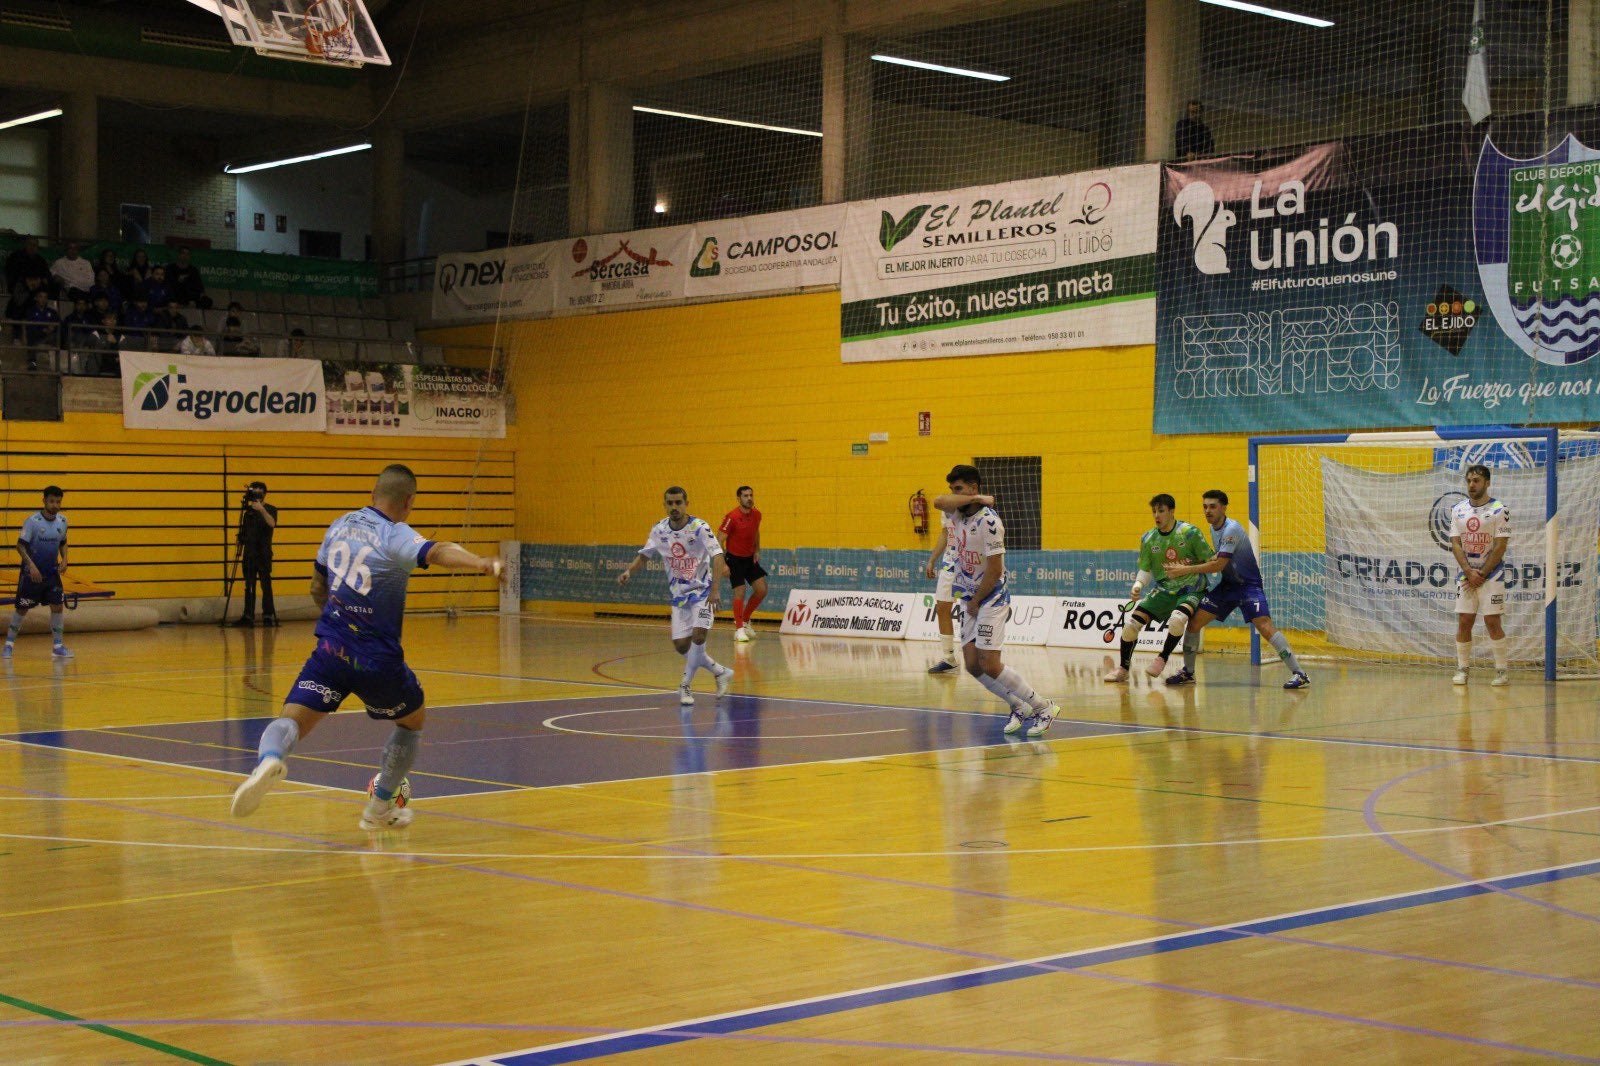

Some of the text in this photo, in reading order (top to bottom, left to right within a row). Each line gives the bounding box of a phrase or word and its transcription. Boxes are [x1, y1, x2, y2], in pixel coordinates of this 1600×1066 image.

[1515, 169, 1546, 181] CLUB
[1250, 179, 1306, 219] La
[924, 191, 1064, 232] El Plantel
[726, 230, 839, 260] CAMPOSOL
[922, 221, 1057, 248] SEMILLEROS
[1250, 212, 1398, 270] unión
[589, 259, 649, 281] Sercasa
[885, 246, 1048, 274] EL MEJOR INJERTO PARA TU COSECHA
[199, 266, 249, 278] INAGROUP
[254, 271, 300, 283] INAGROUP
[305, 273, 351, 284] INAGROUP
[460, 258, 506, 288] nex
[1251, 270, 1398, 291] #Elfuturoquenosune
[1514, 276, 1600, 294] FUTSA
[876, 270, 1114, 326] Tu éxito, nuestra meta
[1425, 315, 1475, 330] EL EJIDO
[176, 384, 317, 419] agroclean
[1416, 373, 1593, 409] La Fuerza que nos
[327, 540, 372, 596] 96
[778, 564, 910, 579] Bioline Bioline Bioline
[1036, 568, 1137, 582] Bioline Bioline
[1337, 553, 1450, 588] CRIADO
[816, 596, 863, 610] SUMINISTROS
[1061, 600, 1086, 608] Frutas
[1253, 602, 1260, 613] 7
[811, 614, 903, 632] Francisco Muñoz Flores
